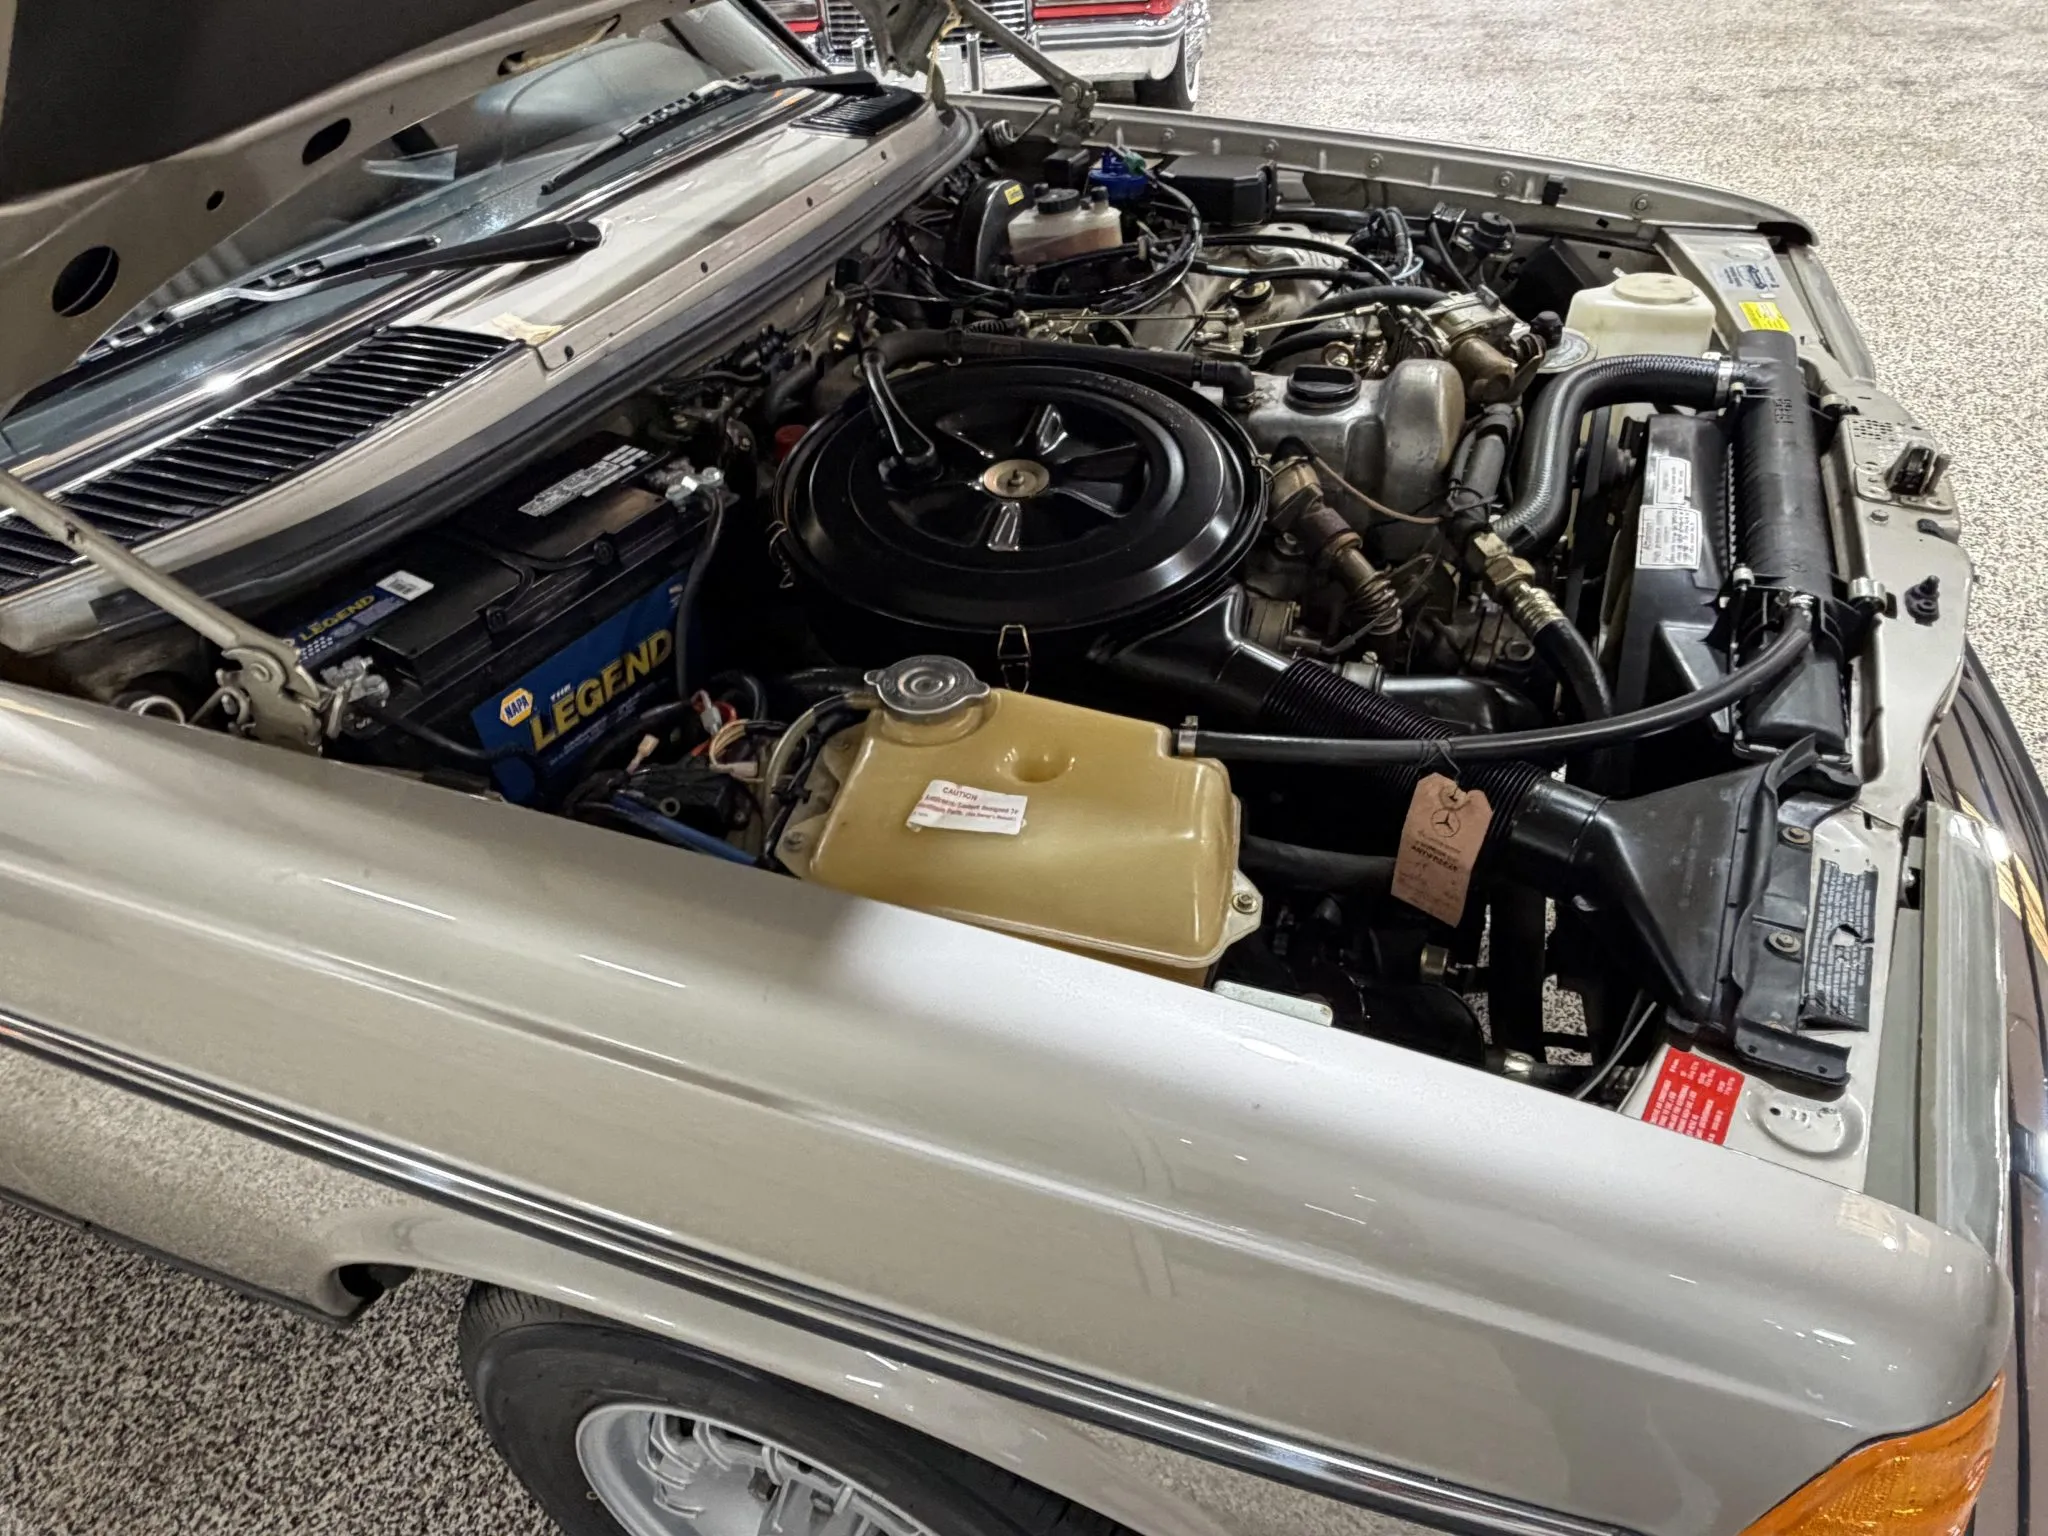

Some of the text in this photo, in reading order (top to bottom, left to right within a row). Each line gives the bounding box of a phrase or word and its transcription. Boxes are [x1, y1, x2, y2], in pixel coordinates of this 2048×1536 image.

[299, 595, 376, 641] LEGEND
[504, 694, 530, 720] NAPA
[529, 628, 673, 753] LEGEND
[942, 786, 978, 801] CAUTION
